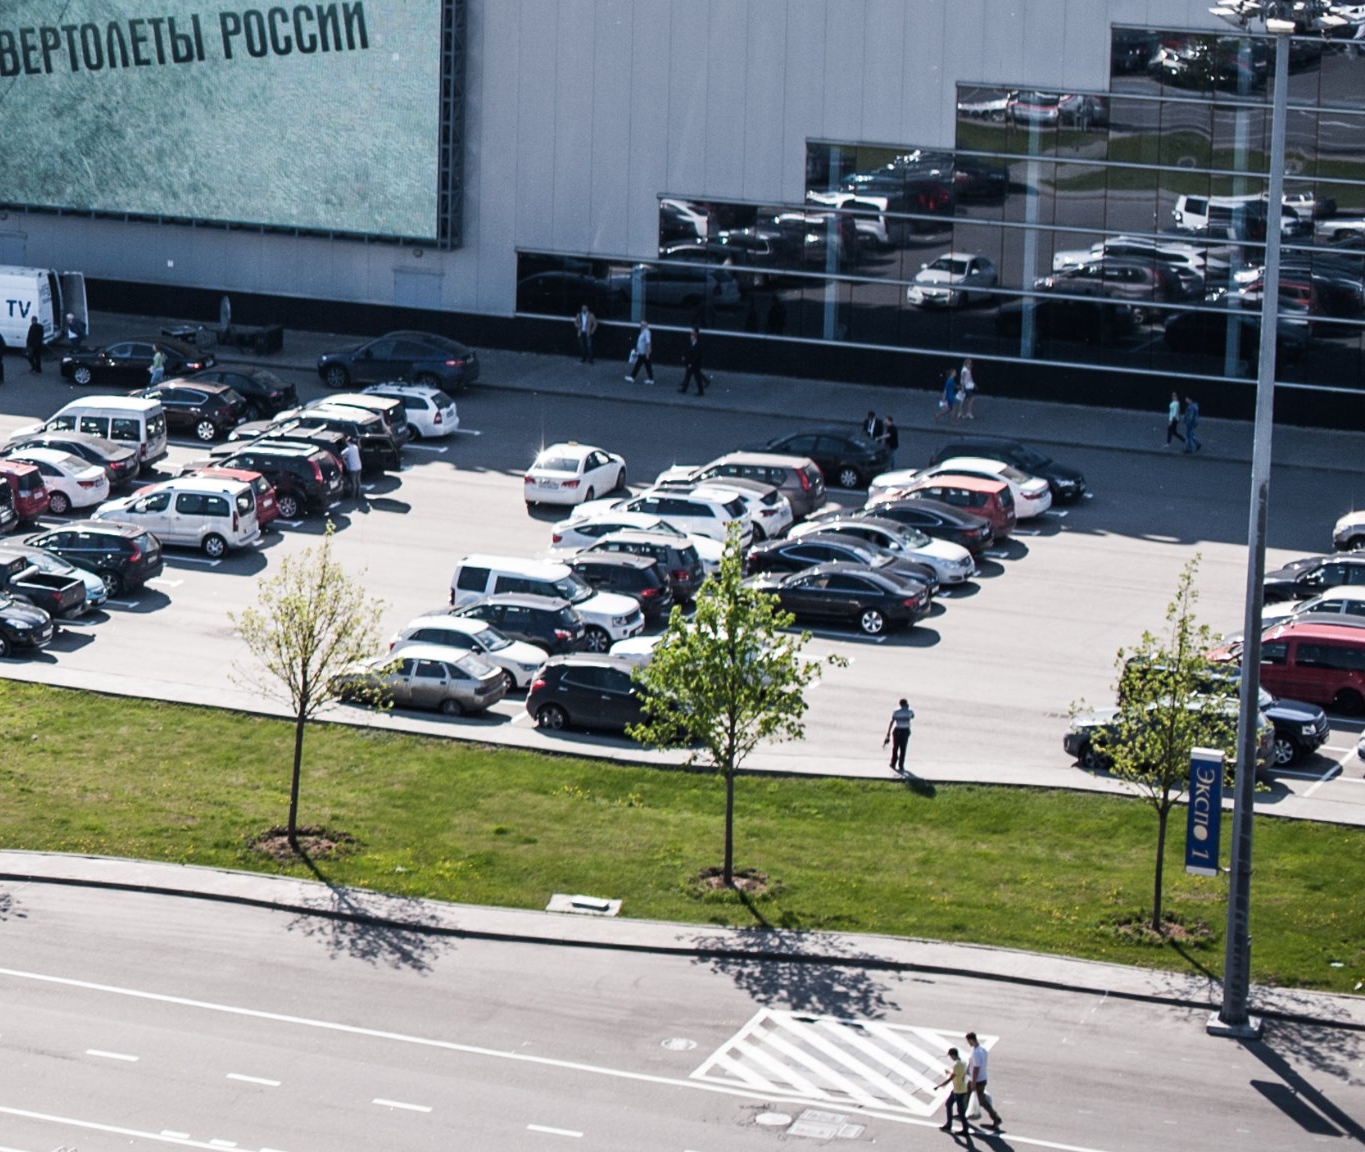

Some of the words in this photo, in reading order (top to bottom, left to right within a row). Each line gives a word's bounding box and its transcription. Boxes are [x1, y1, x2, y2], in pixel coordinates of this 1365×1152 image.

[219, 1, 369, 60] РОССИИ
[6, 299, 31, 319] TV
[1192, 848, 1209, 859] 1
